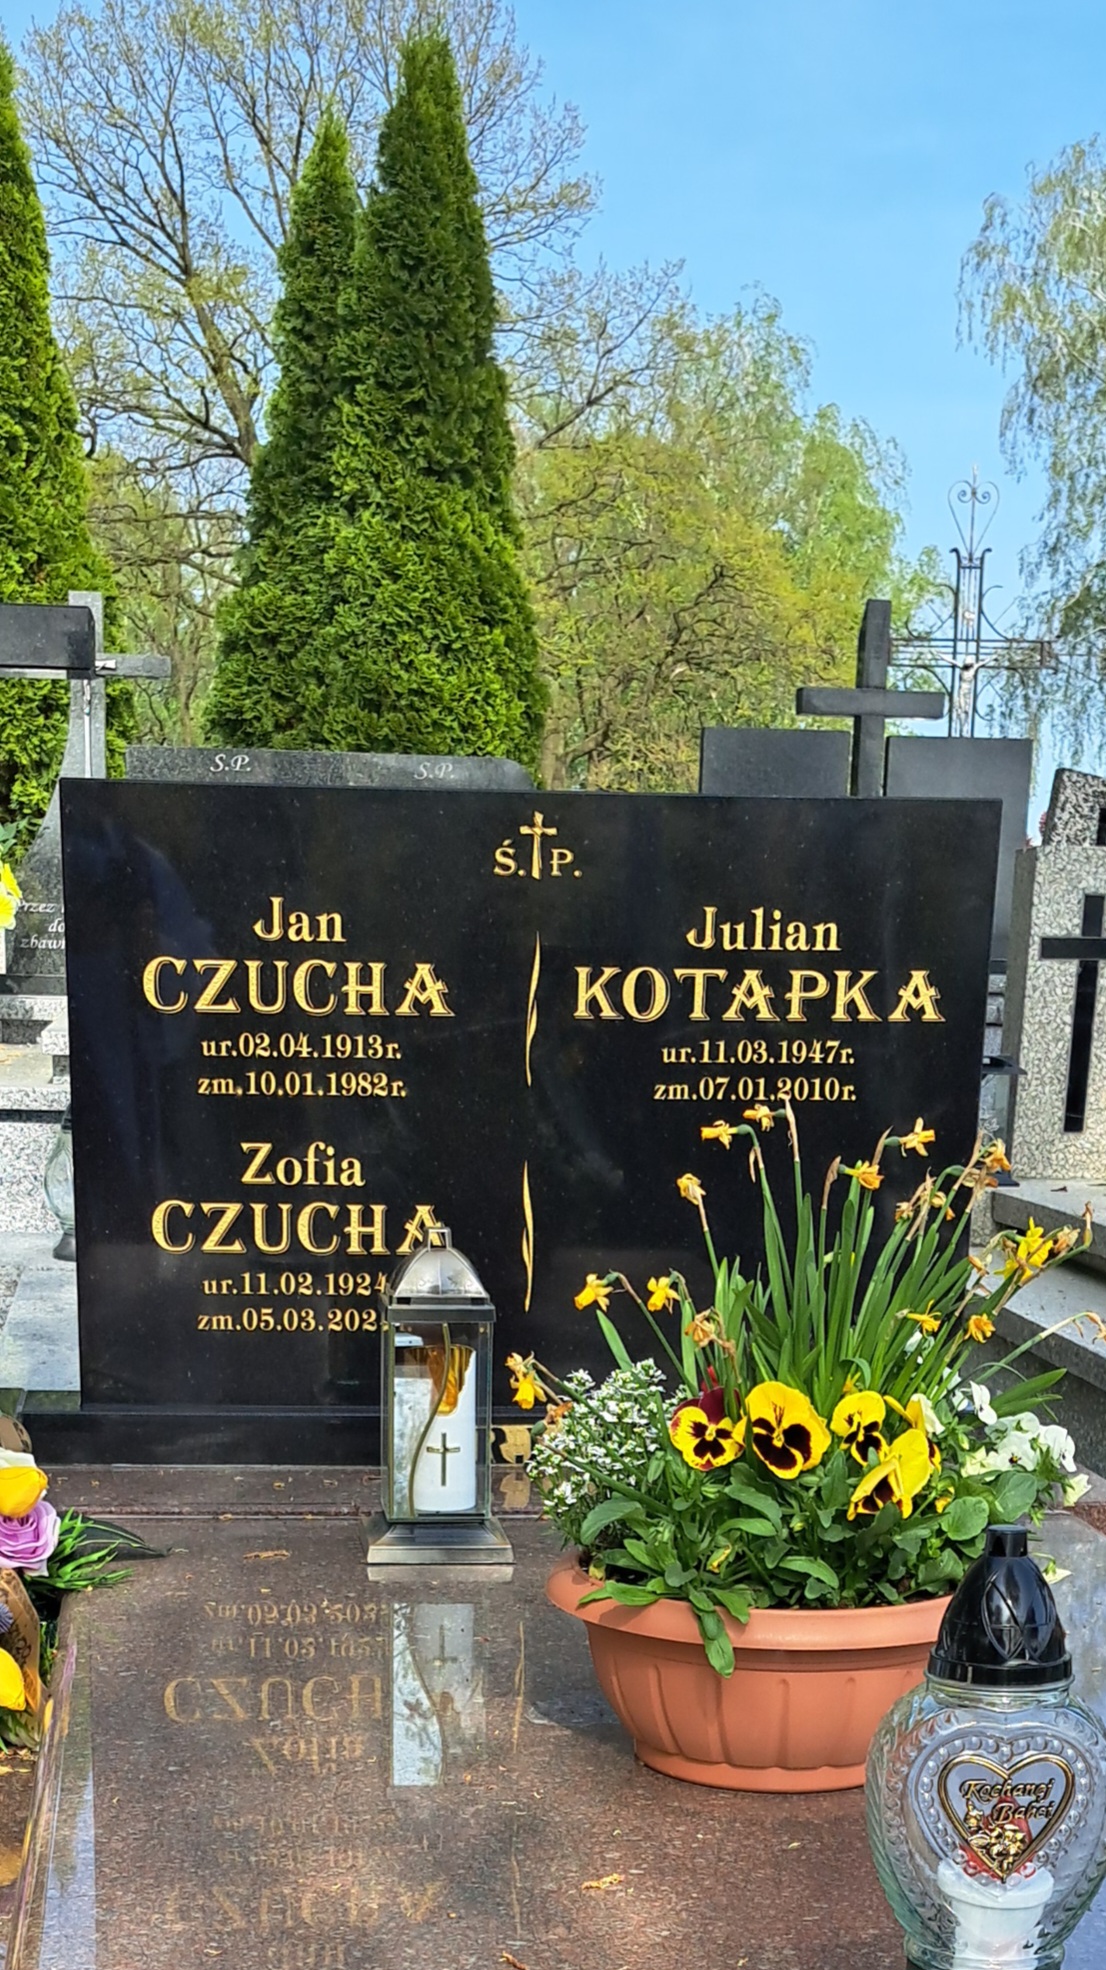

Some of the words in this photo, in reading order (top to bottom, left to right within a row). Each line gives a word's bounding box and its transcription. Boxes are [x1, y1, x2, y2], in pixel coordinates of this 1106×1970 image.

[252, 896, 347, 942] Jan
[686, 906, 841, 952] Julian
[142, 956, 455, 1017] CZUCHA
[573, 966, 946, 1023] KOTAPKA
[240, 1140, 366, 1187] Zofia
[150, 1199, 444, 1256] CZUCHA
